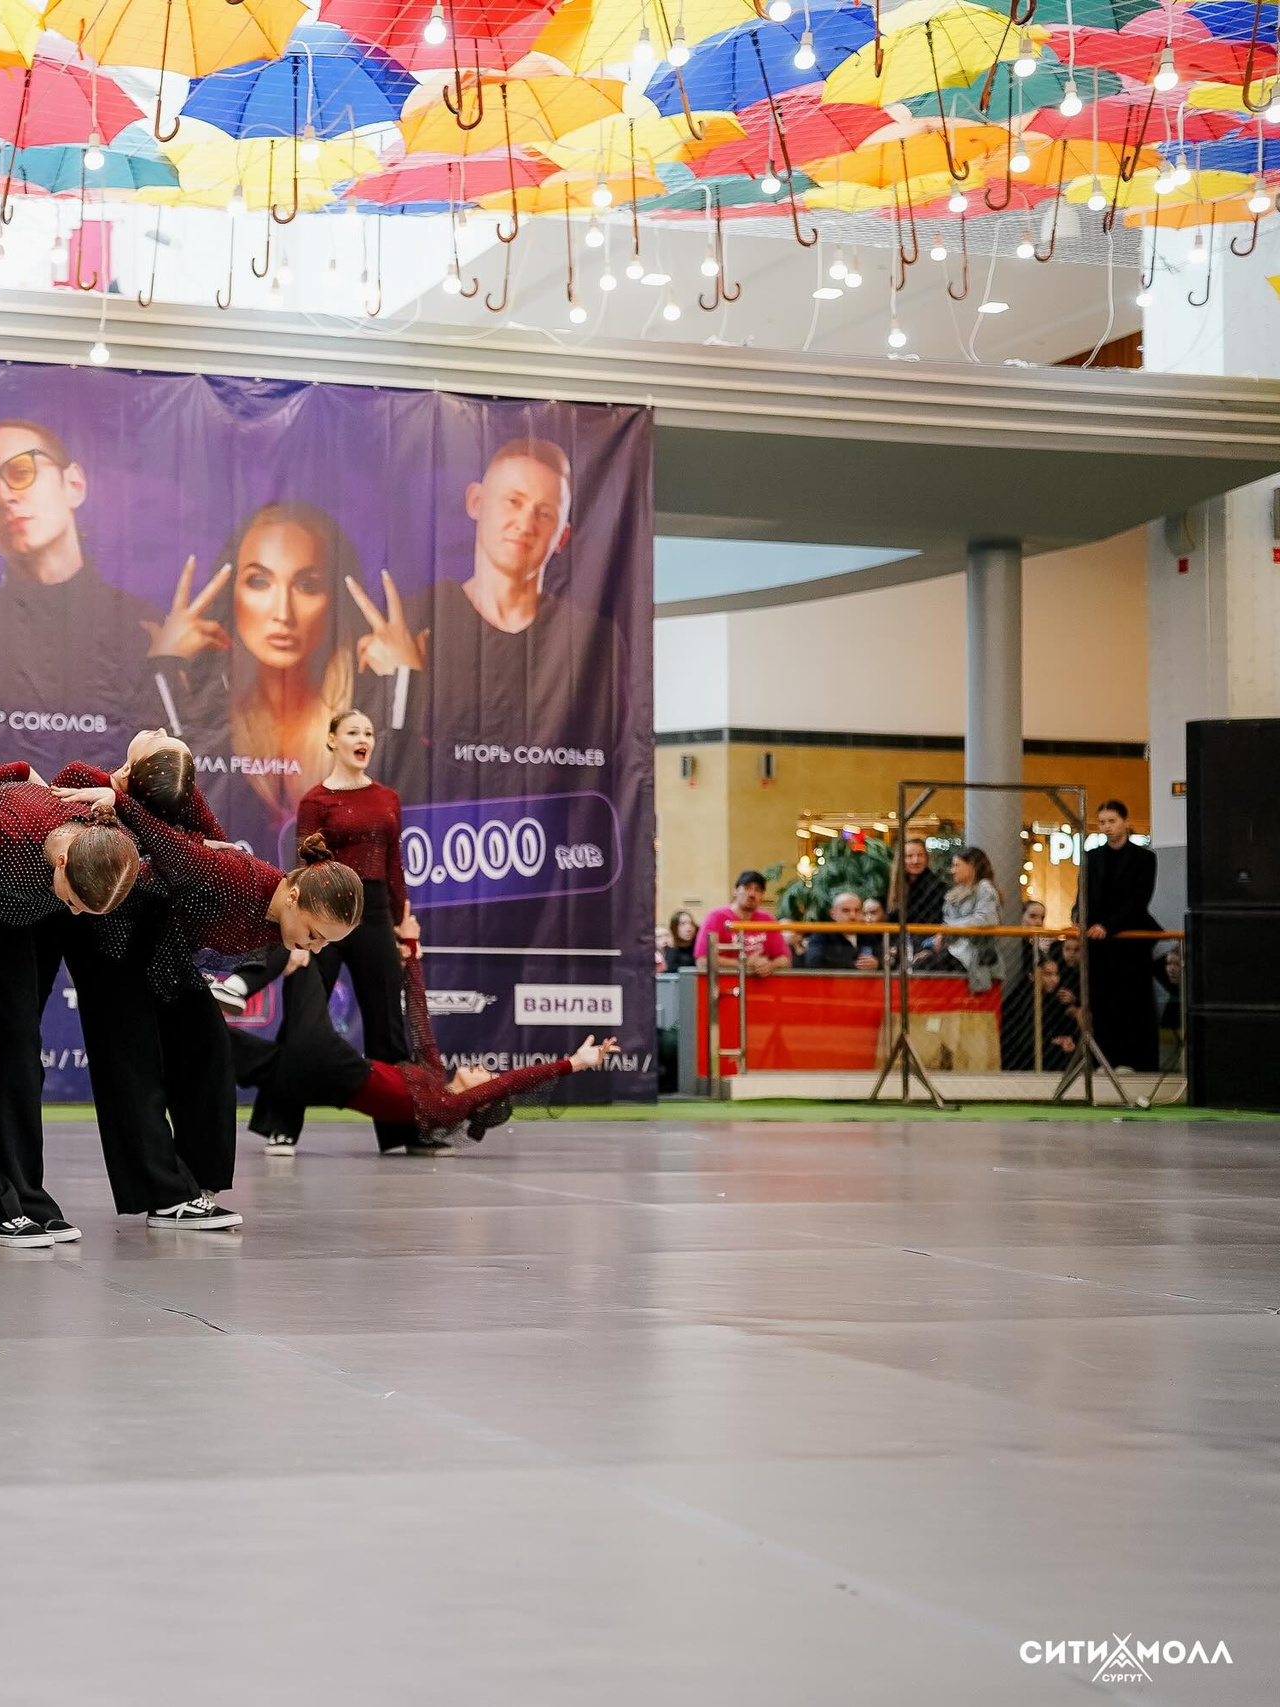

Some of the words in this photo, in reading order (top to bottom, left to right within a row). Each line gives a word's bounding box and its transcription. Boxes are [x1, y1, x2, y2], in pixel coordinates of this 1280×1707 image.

[8, 710, 108, 733] СОКОЛОВ
[230, 755, 302, 776] РЕДИНА
[454, 743, 512, 763] ИГОРЬ
[513, 745, 606, 767] СОЛОВЬЕВ
[400, 817, 546, 887] 0.000
[554, 843, 605, 870] RUB
[522, 996, 613, 1013] ванлав
